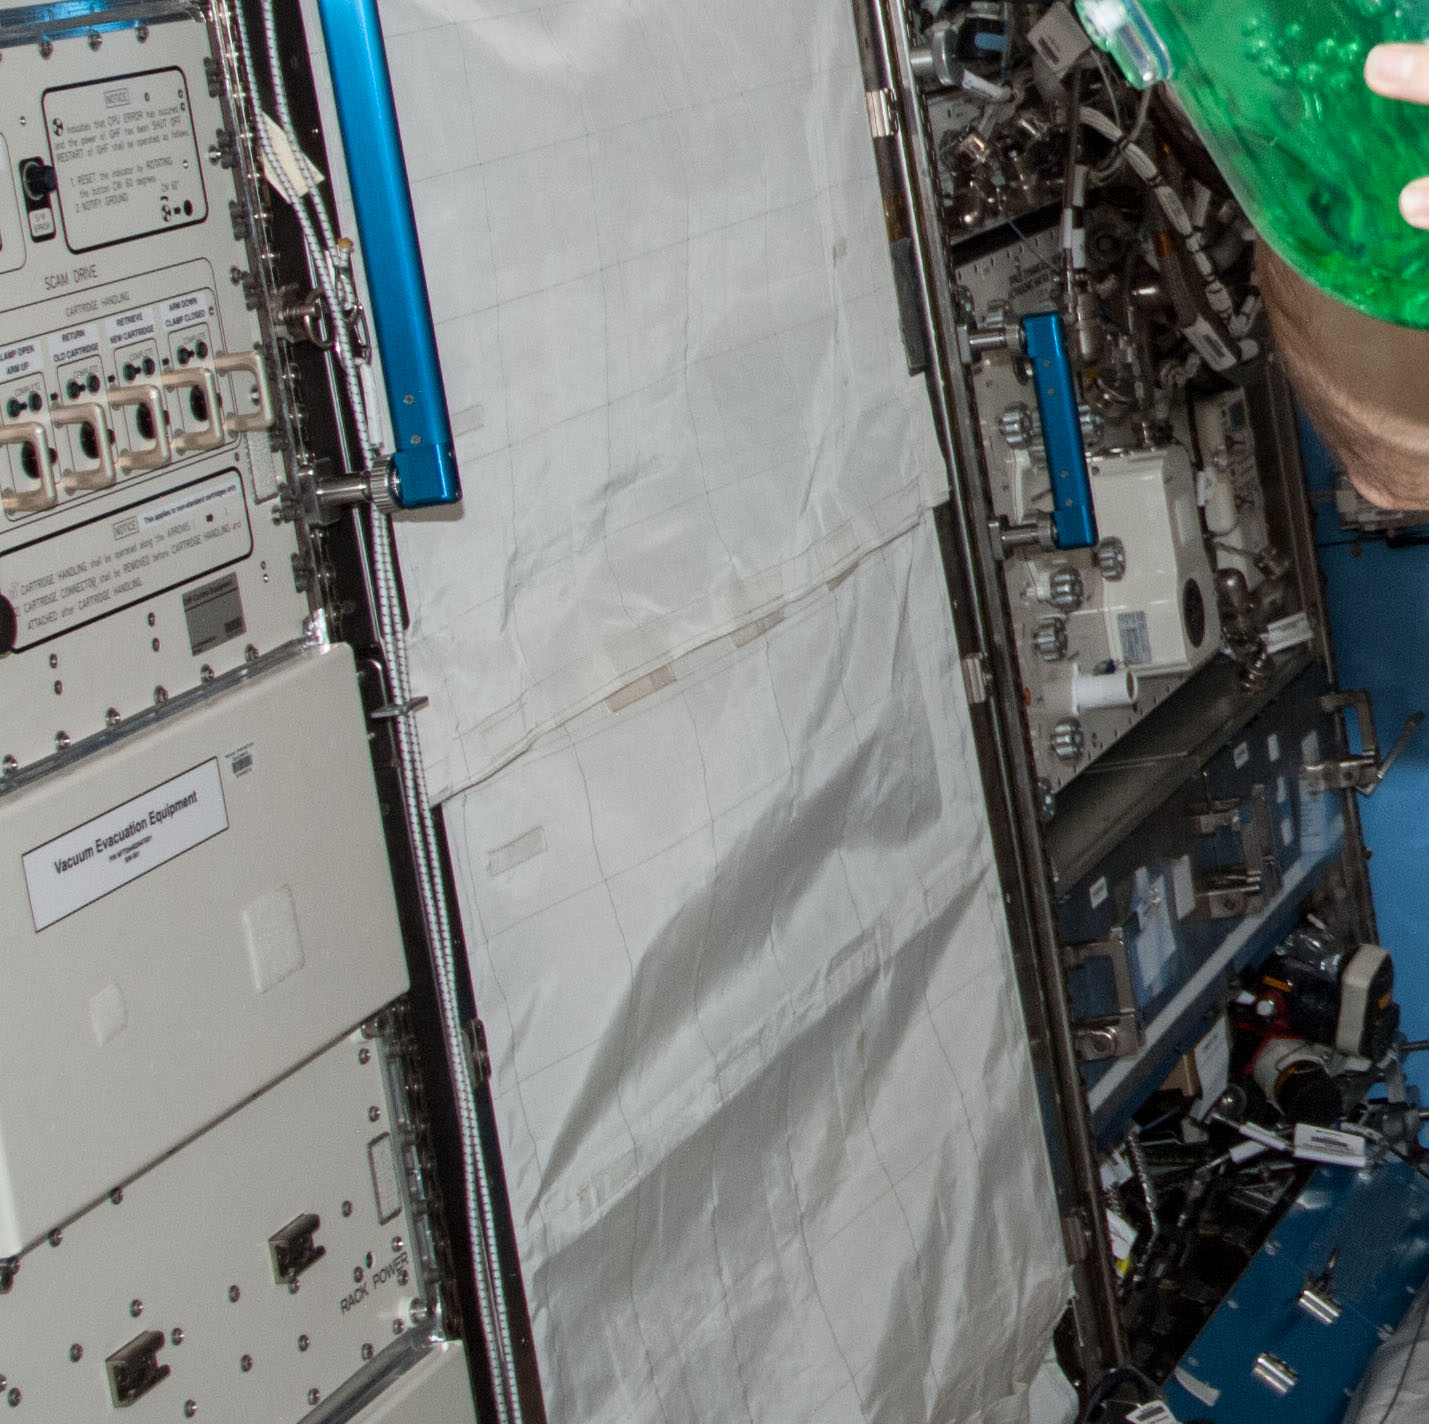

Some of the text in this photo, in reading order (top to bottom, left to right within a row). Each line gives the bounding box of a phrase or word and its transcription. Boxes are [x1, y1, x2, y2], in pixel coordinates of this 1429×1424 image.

[106, 91, 129, 104] NOTICE
[123, 111, 143, 124] ERROR
[56, 148, 84, 163] RESTART
[44, 264, 99, 291] SCAM DRIVE
[65, 291, 131, 318] CARTRIDGE HANDLING
[168, 296, 198, 312] ARM DOWN
[115, 312, 144, 327] RETRIEVE
[165, 309, 206, 328] CLAMP CLOSED
[61, 329, 86, 343] RETURN
[109, 324, 155, 345] NEW CARTRIDGE
[0, 344, 35, 362] LAMP OPEN
[53, 342, 99, 363] OLD CARTRIDGE
[6, 361, 30, 376] ARM UP
[114, 520, 137, 537] NOTICE
[21, 576, 56, 596] CARTRIDGE
[58, 561, 88, 583] HANDLING
[23, 592, 58, 614] CARTRIDGE
[61, 577, 97, 599] CONNECTOR
[122, 555, 151, 575] REMOVED
[171, 534, 202, 555] CARTRIDGE
[204, 524, 232, 542] HANDLING
[27, 610, 59, 630] ATTACHED
[77, 590, 112, 611] CARTRIDGE
[113, 575, 143, 597] HANDLING
[54, 846, 94, 875] Vacuum
[95, 818, 148, 854] Evacuation
[149, 790, 198, 826] Equipment
[340, 1251, 409, 1315] RACK POWER
